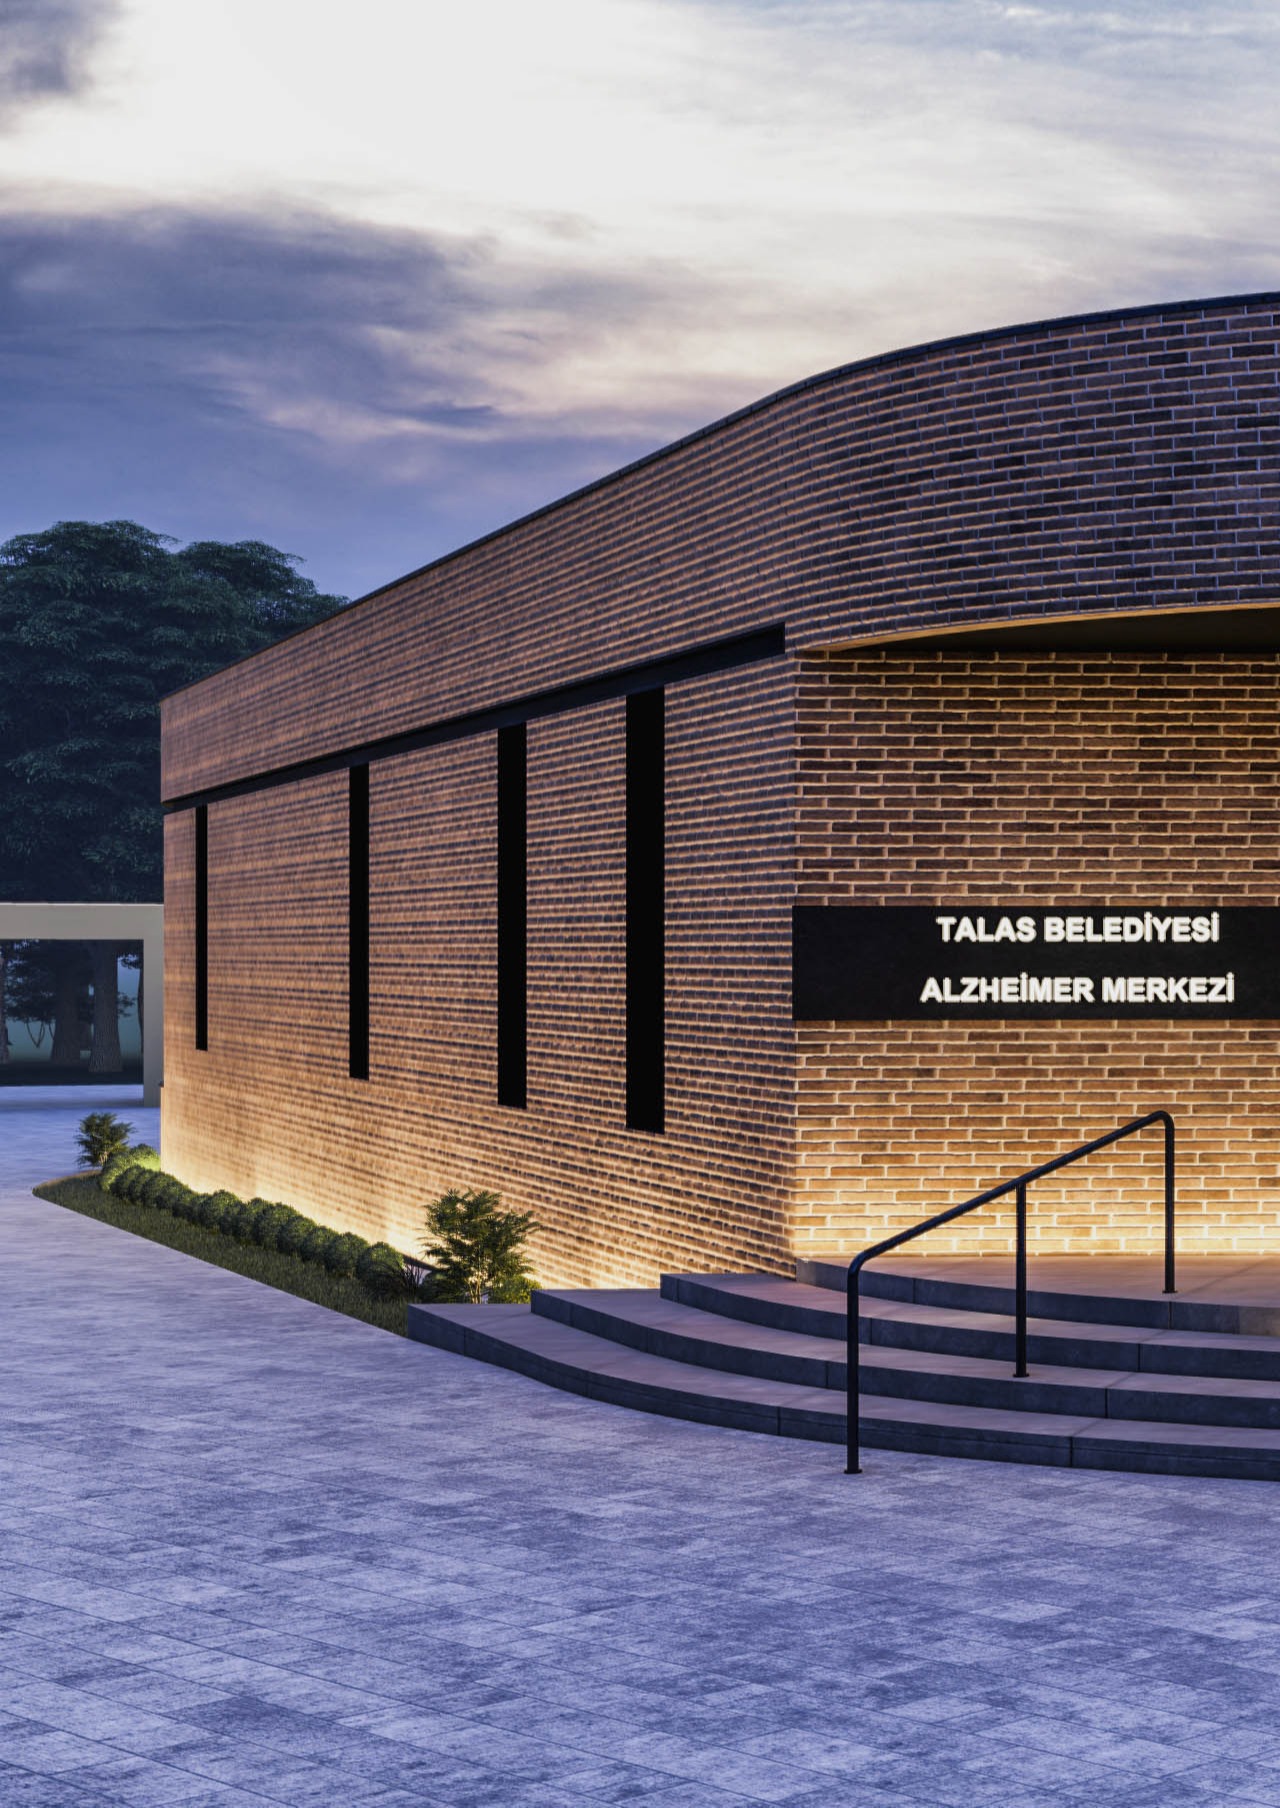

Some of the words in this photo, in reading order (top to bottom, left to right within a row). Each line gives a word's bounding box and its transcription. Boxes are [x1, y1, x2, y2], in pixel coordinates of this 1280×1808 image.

[936, 916, 1036, 943] TALAS
[1044, 911, 1219, 943] BELEDİYESİ
[920, 971, 1095, 1003] ALZHEİMER
[1102, 971, 1235, 1003] MERKEZİ
